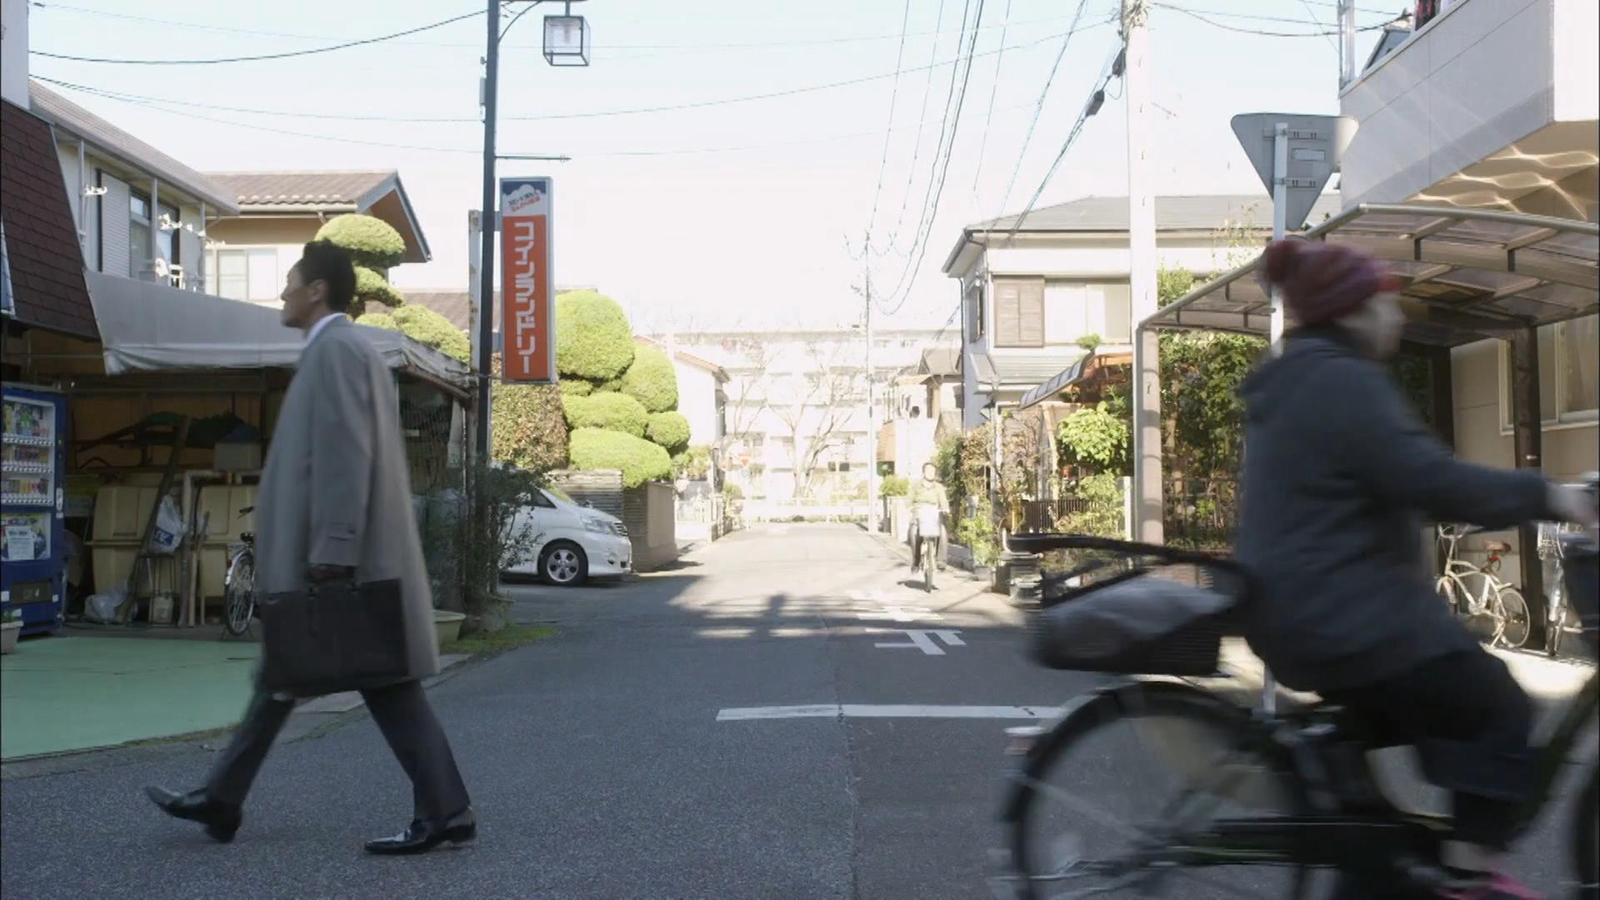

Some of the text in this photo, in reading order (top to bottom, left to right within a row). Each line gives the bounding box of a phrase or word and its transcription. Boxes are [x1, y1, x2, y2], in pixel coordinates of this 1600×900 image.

[514, 222, 535, 374] コインランドリー
